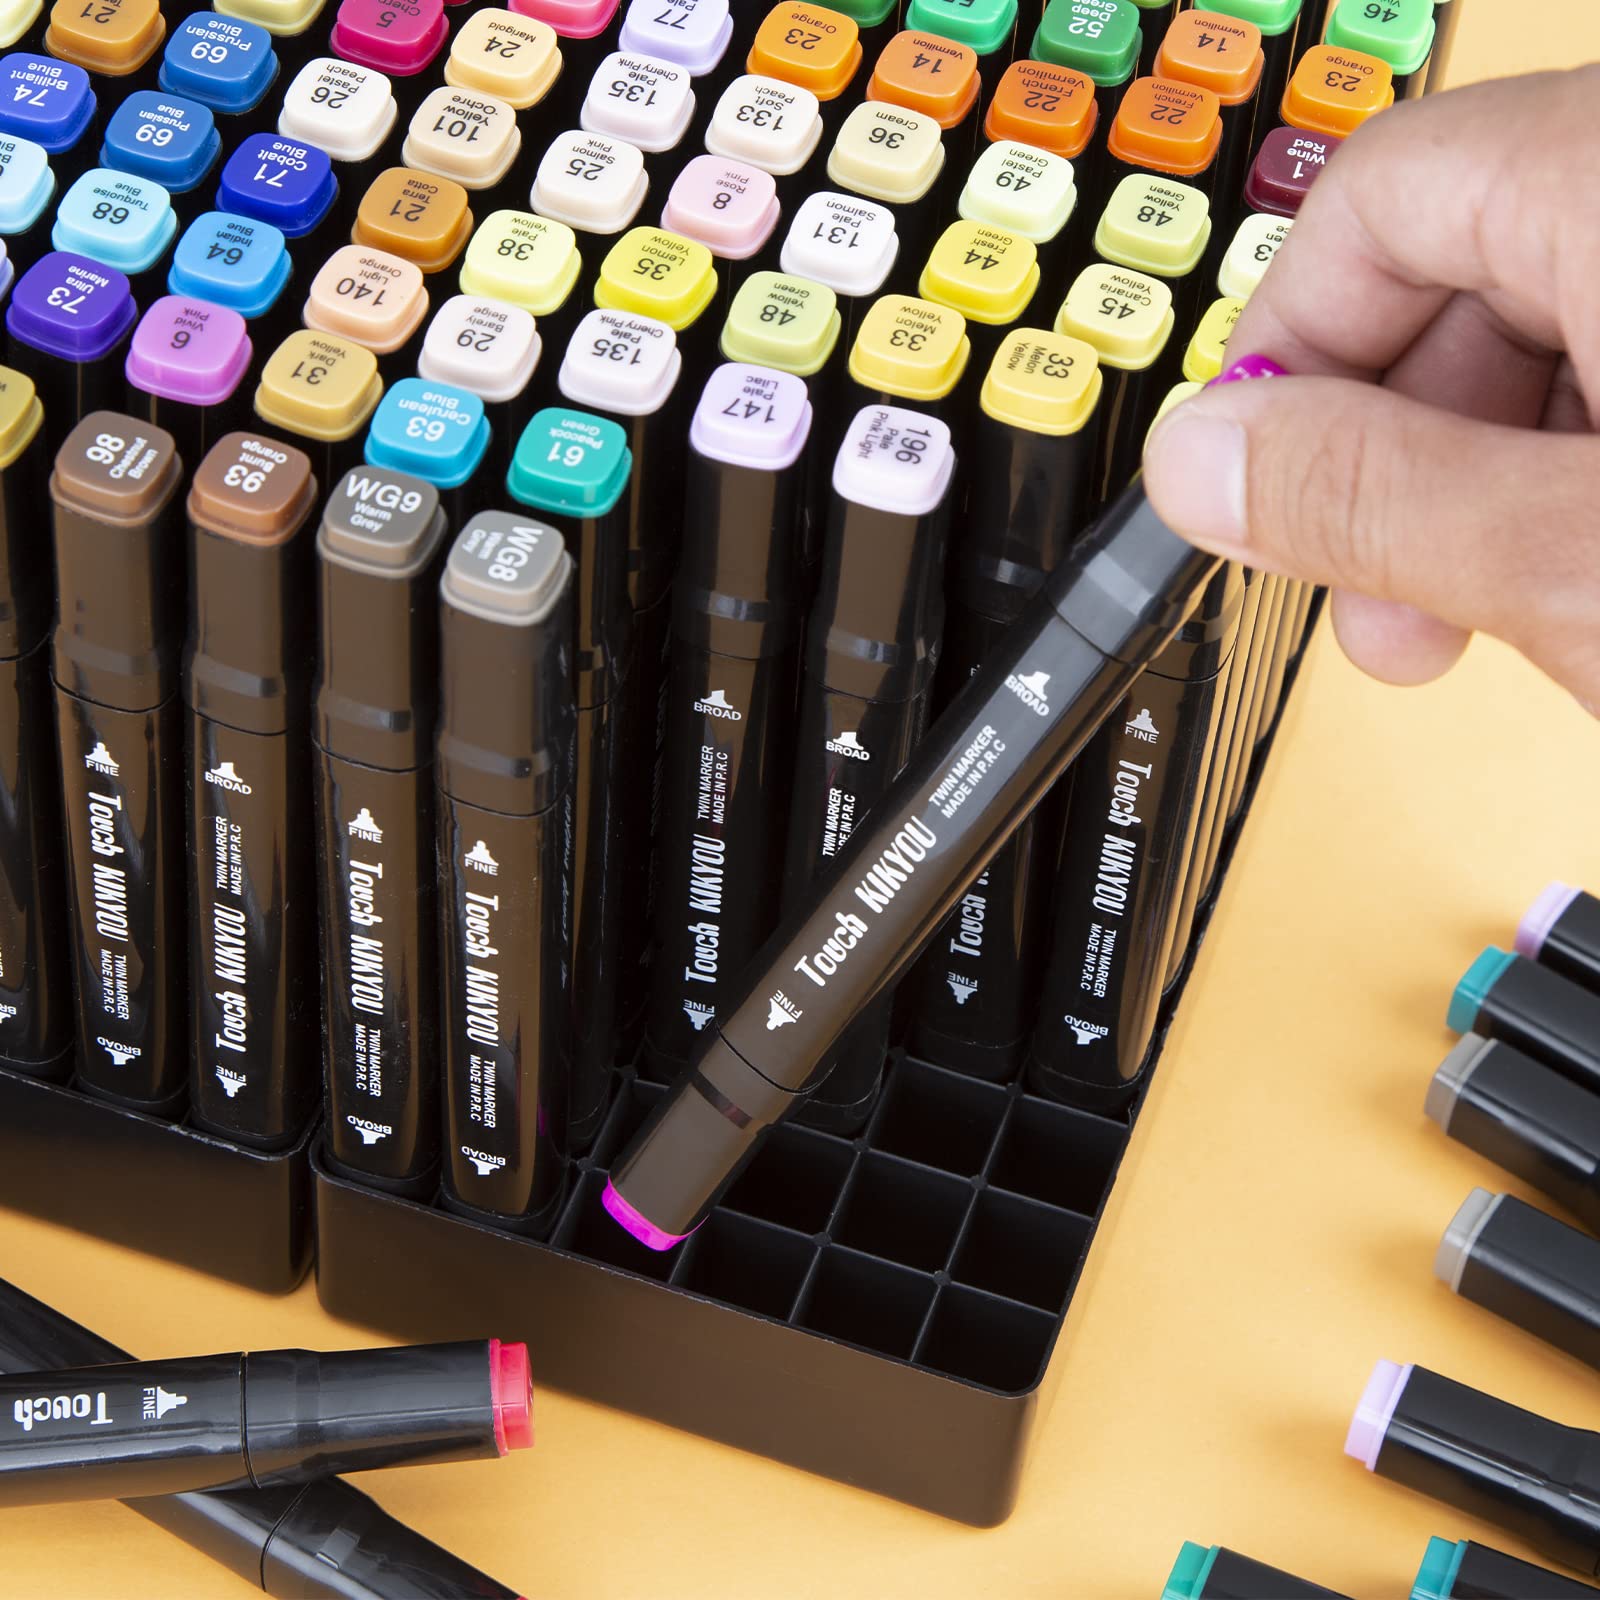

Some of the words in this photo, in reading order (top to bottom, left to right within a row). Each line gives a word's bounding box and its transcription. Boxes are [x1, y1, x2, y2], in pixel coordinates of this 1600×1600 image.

[80, 2, 117, 23] 21
[667, 0, 696, 11] Pale
[1072, 4, 1111, 22] Deep
[1364, 3, 1398, 22] 46
[208, 20, 242, 36] Blue
[376, 11, 396, 28] 5
[653, 9, 689, 29] 77
[791, 12, 837, 34] Orange
[1068, 16, 1105, 38] 52
[186, 26, 252, 51] Prussian
[488, 22, 537, 43] Marigold
[784, 28, 822, 50] 23
[191, 41, 227, 63] 69
[484, 36, 521, 58] 24
[912, 38, 963, 60] Vermilion
[28, 62, 62, 77] Blue
[326, 64, 367, 83] Peach
[618, 57, 643, 71] Pink
[642, 63, 678, 81] Cherry
[912, 53, 942, 74] 14
[10, 70, 69, 91] Brilliant
[318, 75, 359, 93] Pastel
[628, 71, 657, 86] Pale
[1017, 66, 1085, 88] Vermilion
[1022, 78, 1073, 97] French
[13, 84, 48, 107] 74
[311, 87, 349, 109] 26
[608, 80, 656, 106] 135
[755, 85, 795, 104] Peach
[755, 96, 784, 111] Soft
[1023, 91, 1061, 112] 22
[443, 105, 489, 126] Yellow
[452, 95, 496, 115] Ochre
[432, 115, 481, 142] 101
[736, 105, 785, 131] 133
[273, 142, 308, 159] Blue
[573, 146, 616, 164] Salmon
[587, 139, 612, 153] Pink
[1287, 148, 1325, 165] Wine
[1293, 138, 1326, 153] Red
[257, 149, 308, 171] Cobalt
[1001, 160, 1043, 178] Pastel
[1009, 148, 1049, 168] Green
[254, 163, 289, 188] 71
[566, 158, 605, 181] 25
[1292, 162, 1303, 178] 1
[115, 182, 142, 197] Blue
[407, 179, 438, 194] Cotta
[996, 172, 1031, 192] 49
[1150, 185, 1185, 201] Green
[93, 188, 149, 211] Turquoise
[402, 189, 432, 204] Terra
[1144, 195, 1180, 211] Yellow
[92, 202, 129, 225] 68
[389, 199, 426, 222] 21
[826, 201, 876, 221] Salmon
[832, 213, 861, 228] Pale
[1137, 205, 1173, 227] 48
[216, 231, 253, 247] Indian
[227, 222, 254, 236] Blue
[813, 222, 860, 248] 131
[977, 229, 1012, 245] Green
[207, 242, 243, 265] 64
[642, 245, 686, 266] Lemon
[651, 235, 690, 256] Yellow
[974, 238, 1007, 255] Fresh
[633, 258, 671, 281] 35
[963, 249, 999, 271] 44
[66, 277, 94, 294] Ultra
[68, 266, 109, 287] Marine
[1110, 275, 1151, 294] Yellow
[47, 286, 86, 314] 73
[1100, 283, 1152, 306] Canaria
[900, 306, 942, 324] Yellow
[1098, 298, 1135, 320] 45
[896, 317, 937, 334] Melon
[310, 339, 347, 358] Yellow
[890, 329, 927, 352] 33
[309, 352, 337, 367] Dark
[1008, 342, 1030, 370] Yellow
[1024, 346, 1047, 374] Melon
[1043, 352, 1074, 380] 33
[291, 361, 328, 385] 31
[746, 376, 779, 390] Lilac
[422, 392, 459, 409] Blue
[743, 386, 774, 400] Pale
[399, 399, 471, 426] Cerulean
[722, 398, 776, 424] 147
[406, 417, 445, 442] 63
[869, 411, 889, 434] Pink
[86, 433, 125, 464] 98
[549, 428, 604, 449] Peacock
[857, 434, 875, 460] Light
[879, 427, 899, 449] Pale
[895, 428, 932, 465] 196
[109, 437, 148, 479] Chestnut
[239, 452, 274, 473] Burnt
[241, 441, 288, 463] Orange
[547, 441, 584, 467] 61
[128, 449, 158, 480] Brown
[223, 464, 266, 493] 93
[346, 474, 422, 514] WG9
[354, 502, 392, 521] Warm
[488, 526, 543, 582] WG8
[1004, 675, 1049, 717] BROAD
[694, 702, 741, 721] BROAD
[1124, 727, 1158, 744] FINE
[826, 741, 870, 761] BROAD
[86, 760, 119, 776] FINE
[699, 745, 714, 790] MARKER
[929, 773, 958, 807] TWIN
[955, 725, 997, 778] MARKER
[205, 771, 251, 795] BROAD
[940, 786, 971, 819] MADE
[968, 772, 984, 791] IN
[977, 739, 1006, 777] P.R.C
[1107, 760, 1152, 827] Touch
[697, 792, 710, 820] TWIN
[826, 788, 842, 827] MARKER
[89, 791, 124, 856] Touch
[216, 816, 227, 861] MARKER
[349, 827, 383, 843] FINE
[822, 828, 836, 857] TWIN
[216, 862, 227, 889] TWIN
[465, 858, 498, 876] FINE
[689, 834, 725, 913] KIKYOU
[1092, 834, 1136, 916] KIKYOU
[93, 863, 128, 941] KIKYOU
[350, 859, 383, 926] Touch
[794, 911, 868, 986] Touch
[854, 815, 937, 913] KIKYOU
[466, 892, 498, 958] Touch
[214, 902, 246, 984] KIKYOU
[685, 922, 720, 983] Touch
[351, 934, 383, 1015] KIKYOU
[466, 965, 499, 1047] KIKYOU
[774, 990, 802, 1019] FINE
[215, 991, 246, 1052] Touch
[1064, 1015, 1108, 1036] BROAD
[97, 1036, 141, 1056] BROAD
[355, 1023, 366, 1051] MADE
[370, 1029, 381, 1053] TWIN
[355, 1051, 366, 1063] IN
[355, 1063, 367, 1091] P.R.C
[370, 1054, 381, 1097] MARKER
[347, 1115, 392, 1135] BROAD
[14, 1392, 113, 1431] Touch
[143, 1388, 155, 1420] FINE
